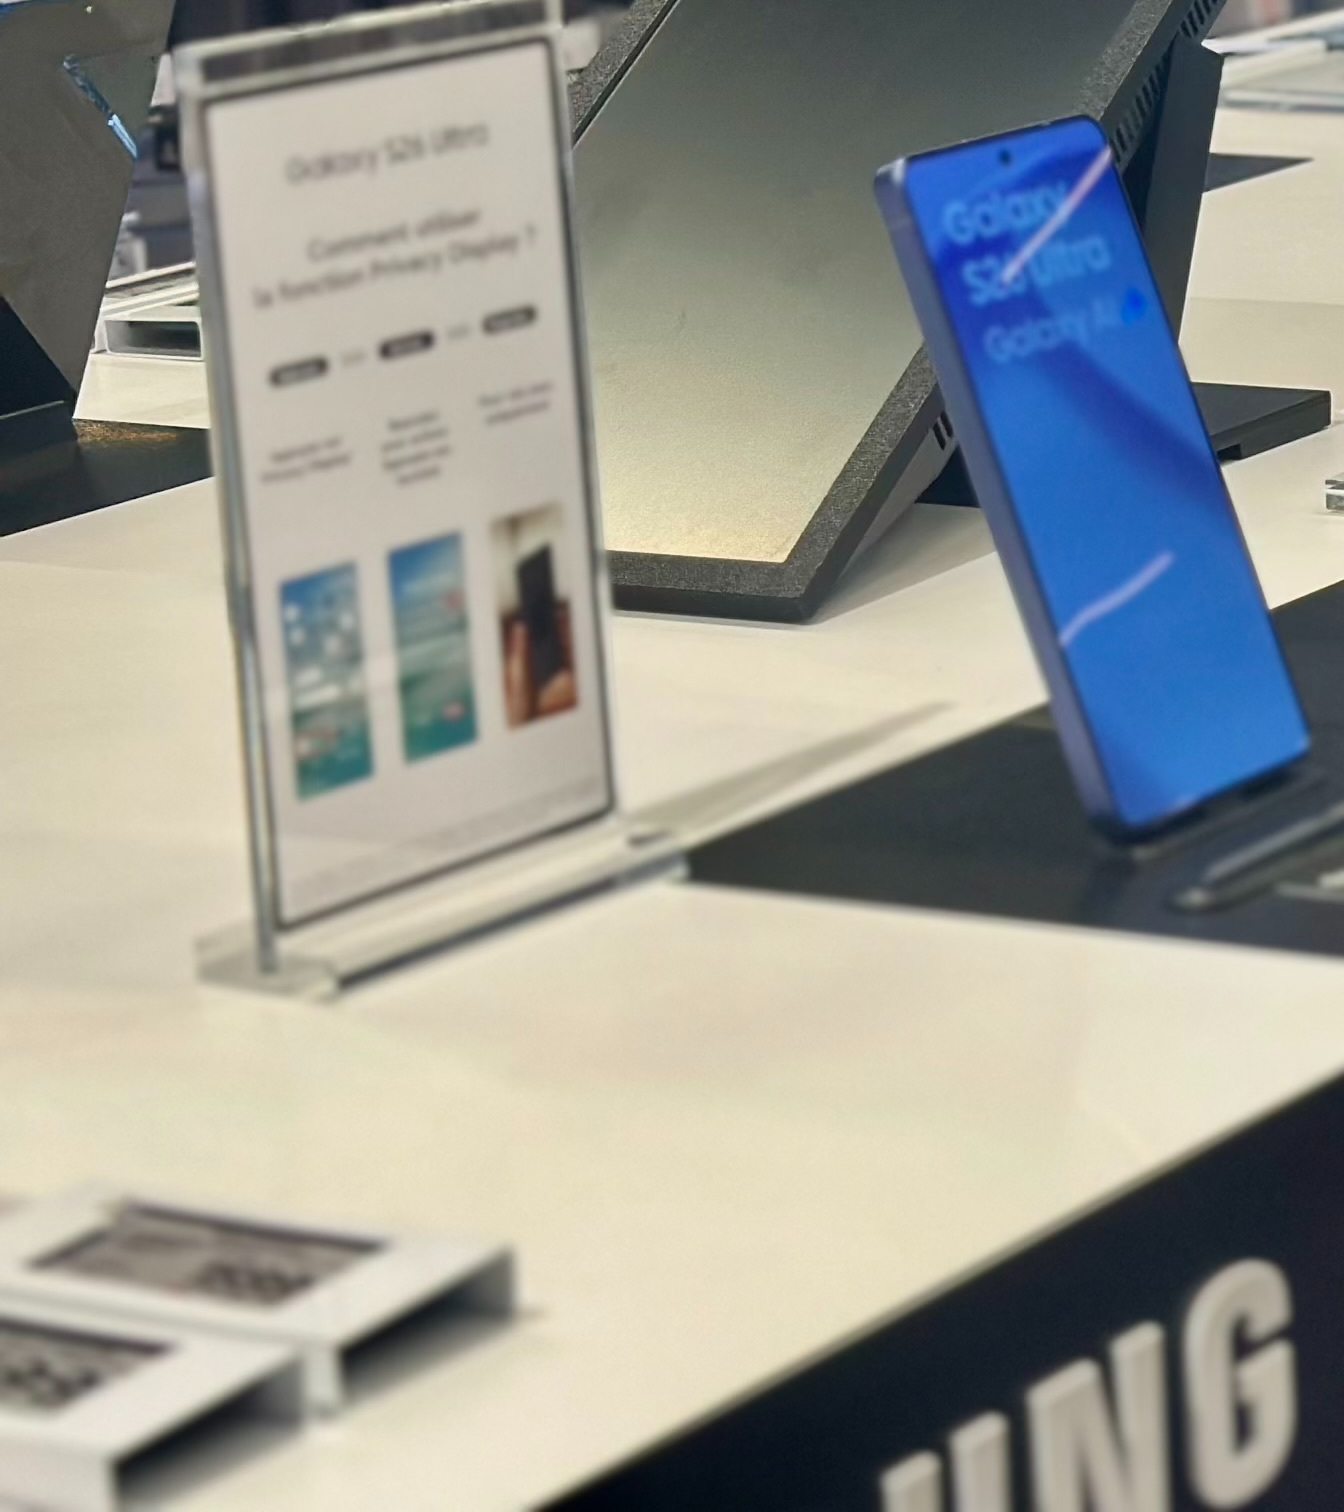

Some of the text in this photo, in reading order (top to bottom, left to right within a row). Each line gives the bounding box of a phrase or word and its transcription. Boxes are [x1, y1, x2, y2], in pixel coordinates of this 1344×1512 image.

[286, 123, 490, 185] Galaxy S26 Ultra
[943, 179, 1069, 245] Galaxy
[309, 223, 408, 262] Comment
[370, 251, 443, 281] Privacy
[449, 234, 519, 265] Display
[1029, 234, 1112, 289] Ultra
[984, 309, 1089, 364] Galaxy
